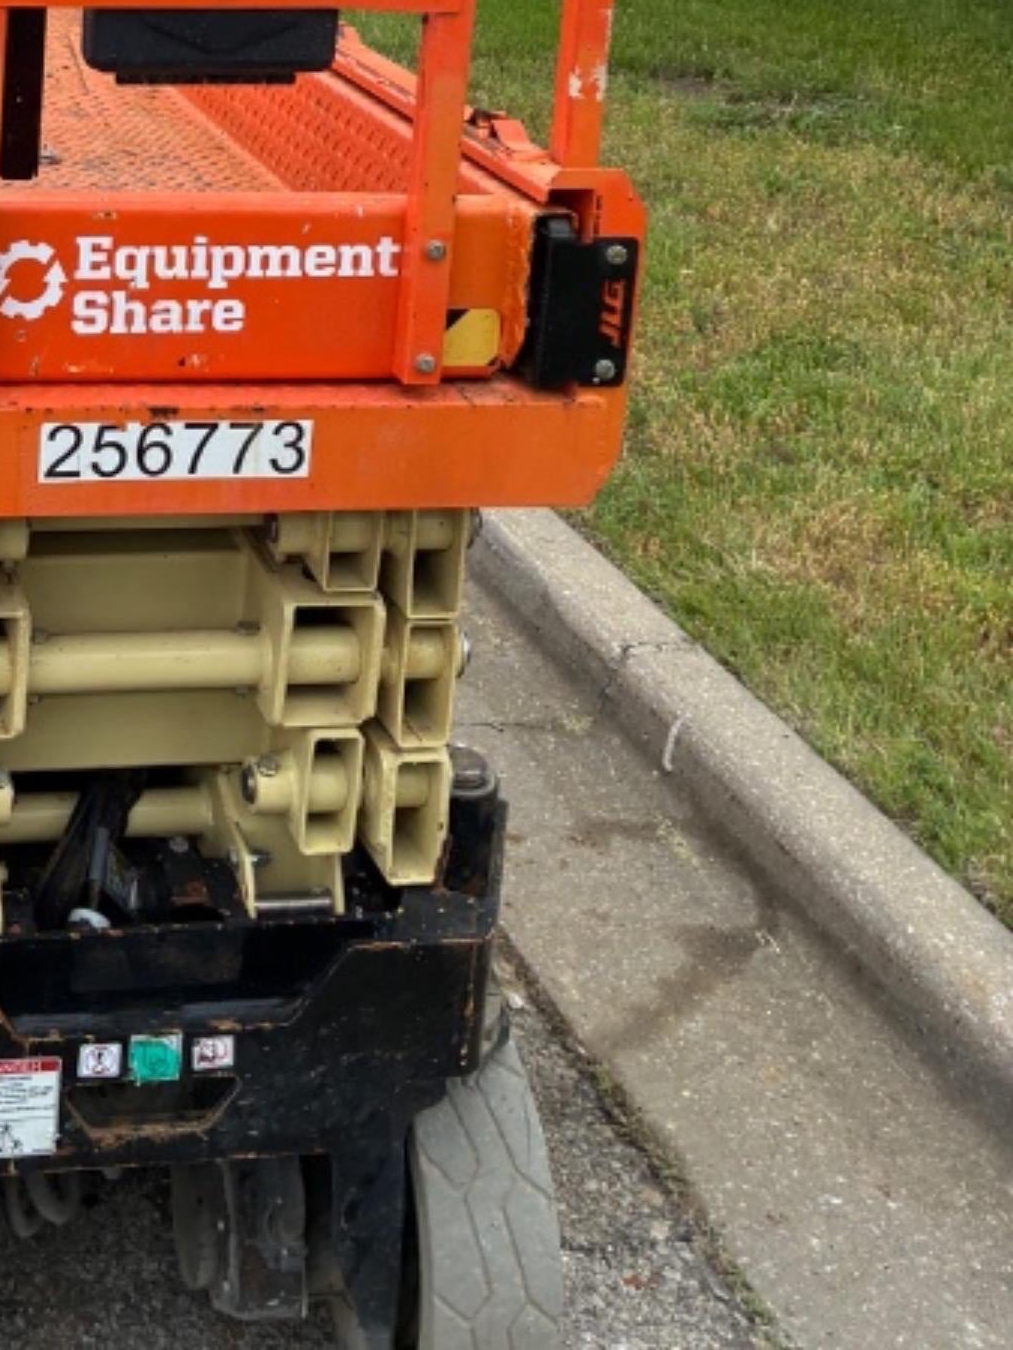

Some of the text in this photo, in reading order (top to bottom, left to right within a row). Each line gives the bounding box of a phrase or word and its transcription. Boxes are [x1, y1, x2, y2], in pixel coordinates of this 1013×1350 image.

[74, 235, 401, 289] Equipment
[71, 290, 246, 335] Share
[599, 277, 625, 349] JLG
[43, 420, 307, 479] 256773
